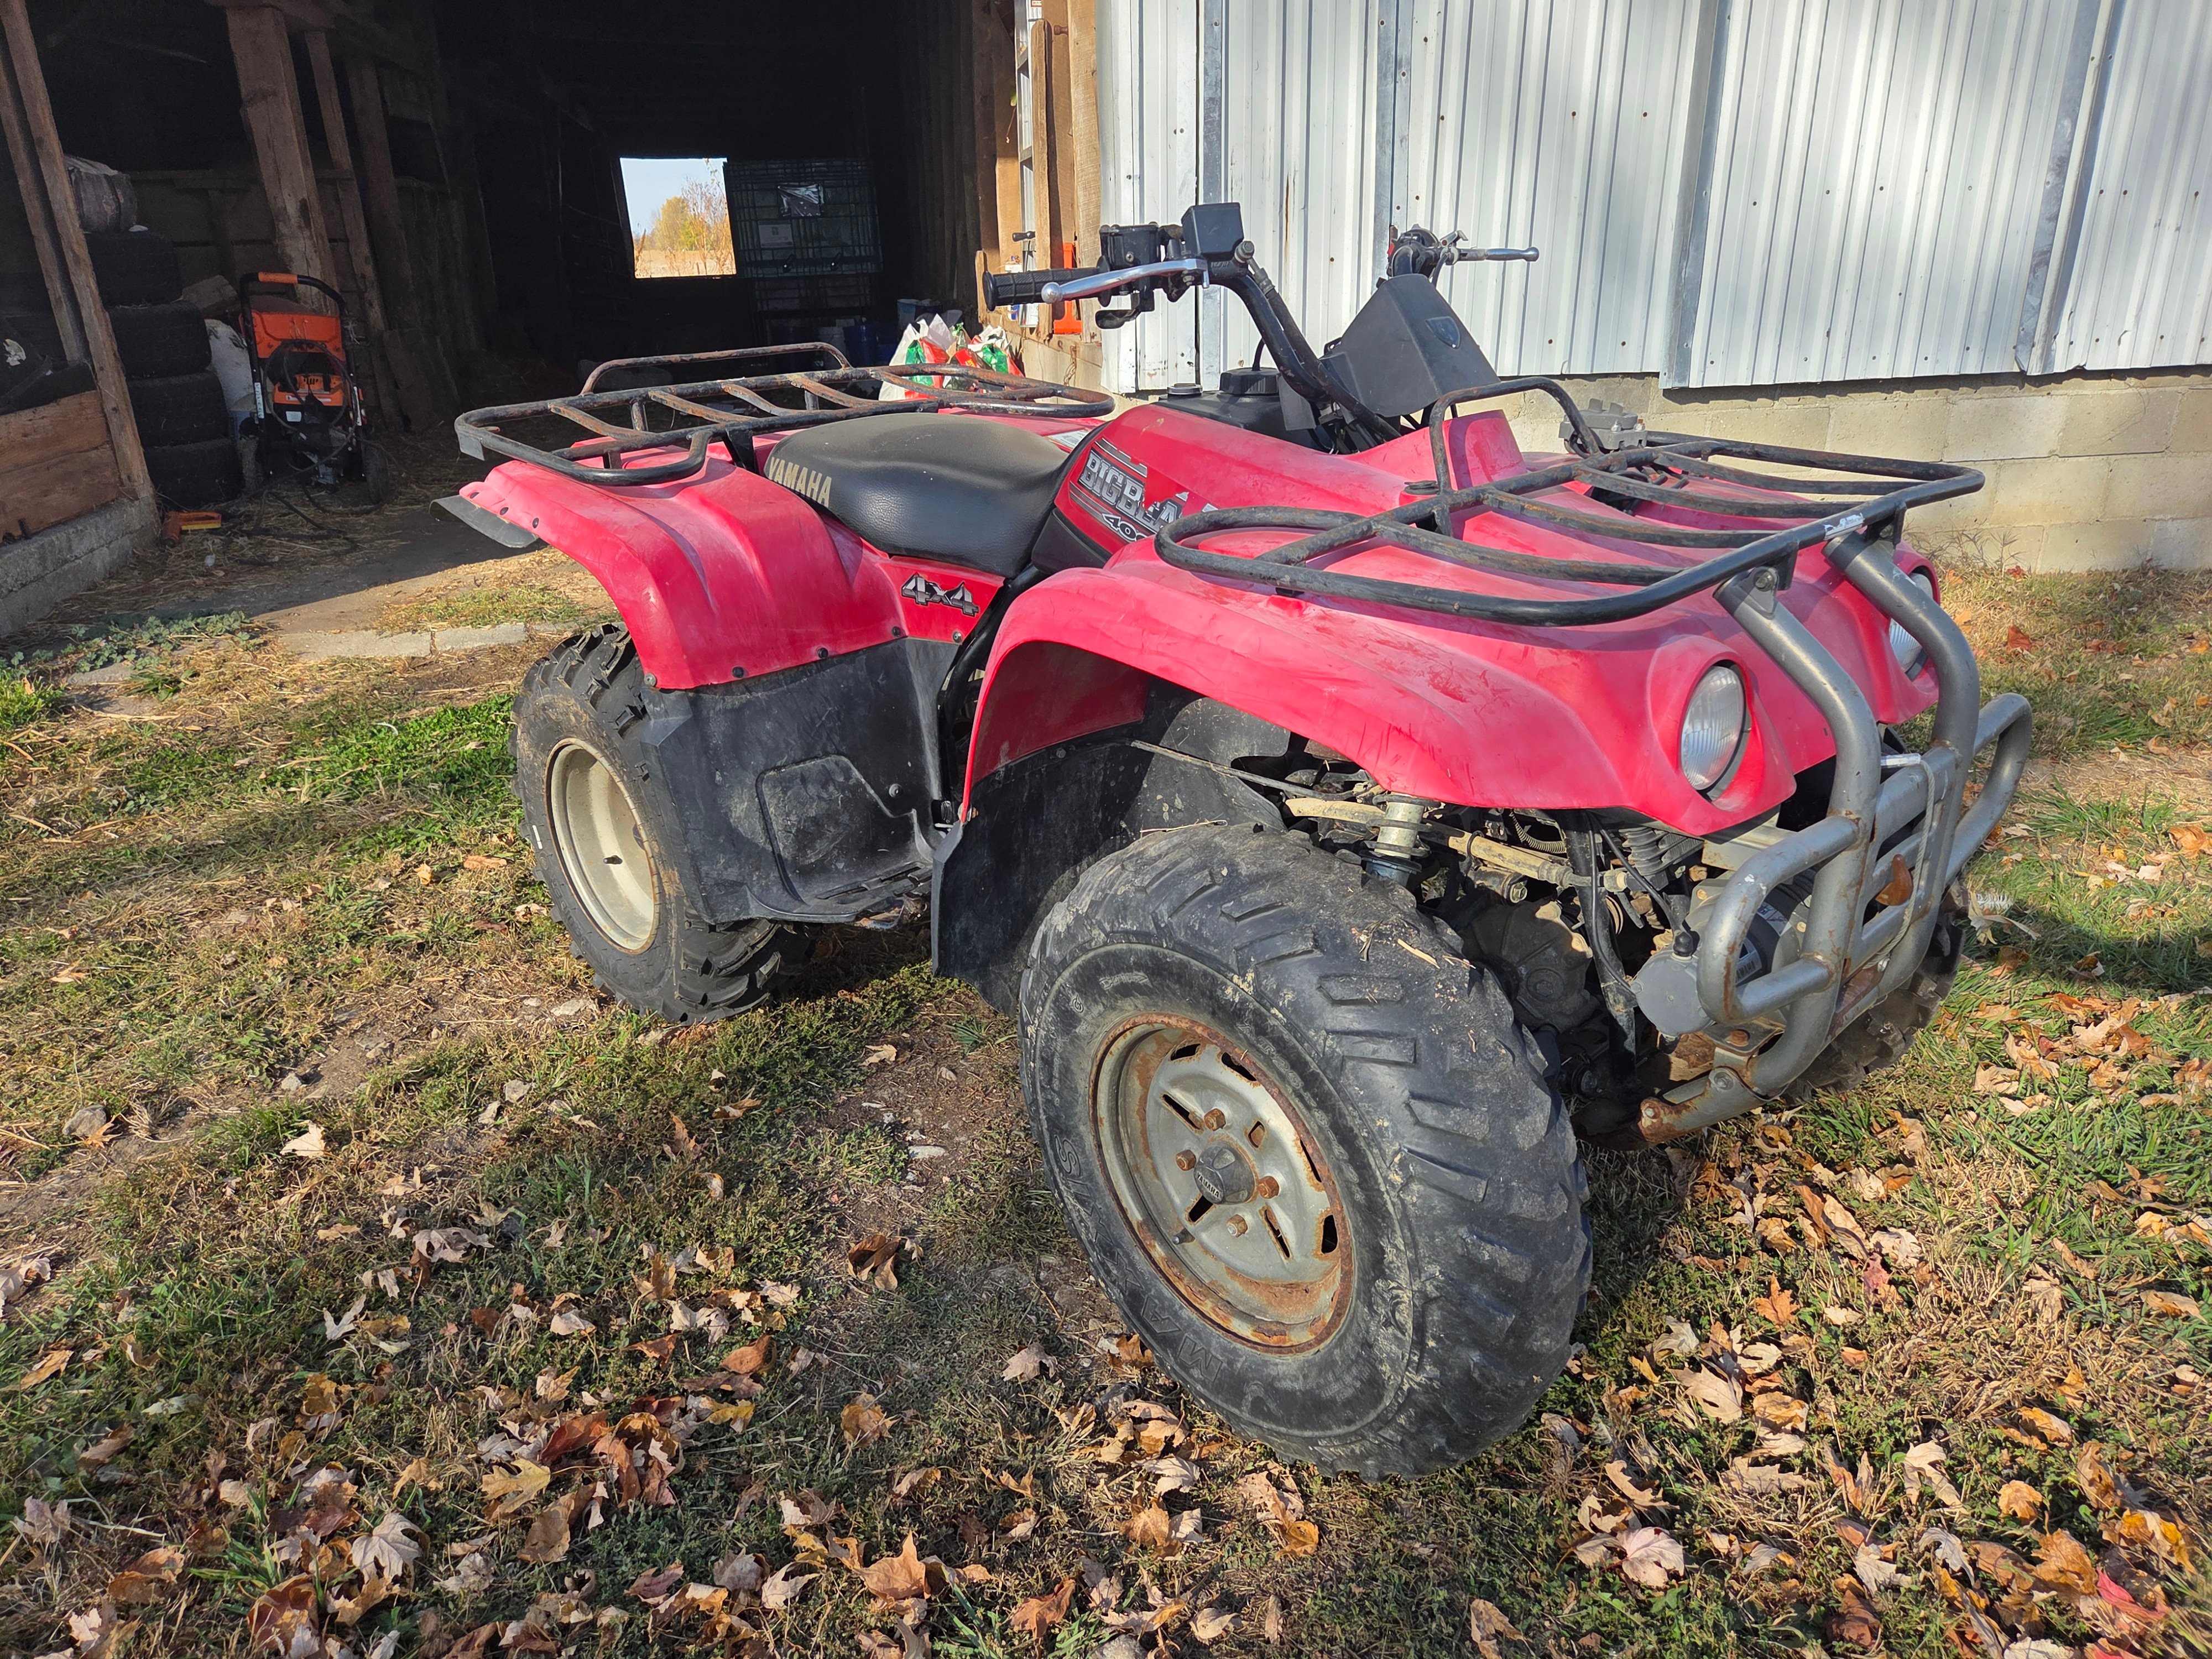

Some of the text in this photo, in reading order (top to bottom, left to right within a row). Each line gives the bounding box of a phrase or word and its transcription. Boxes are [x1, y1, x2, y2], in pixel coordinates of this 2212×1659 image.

[769, 456, 832, 508] YAMAHA
[1078, 449, 1125, 505] BIG
[1102, 513, 1148, 542] 40
[1196, 1170, 1221, 1199] YAMAHA
[1054, 1134, 1224, 1383] MAXXIS
